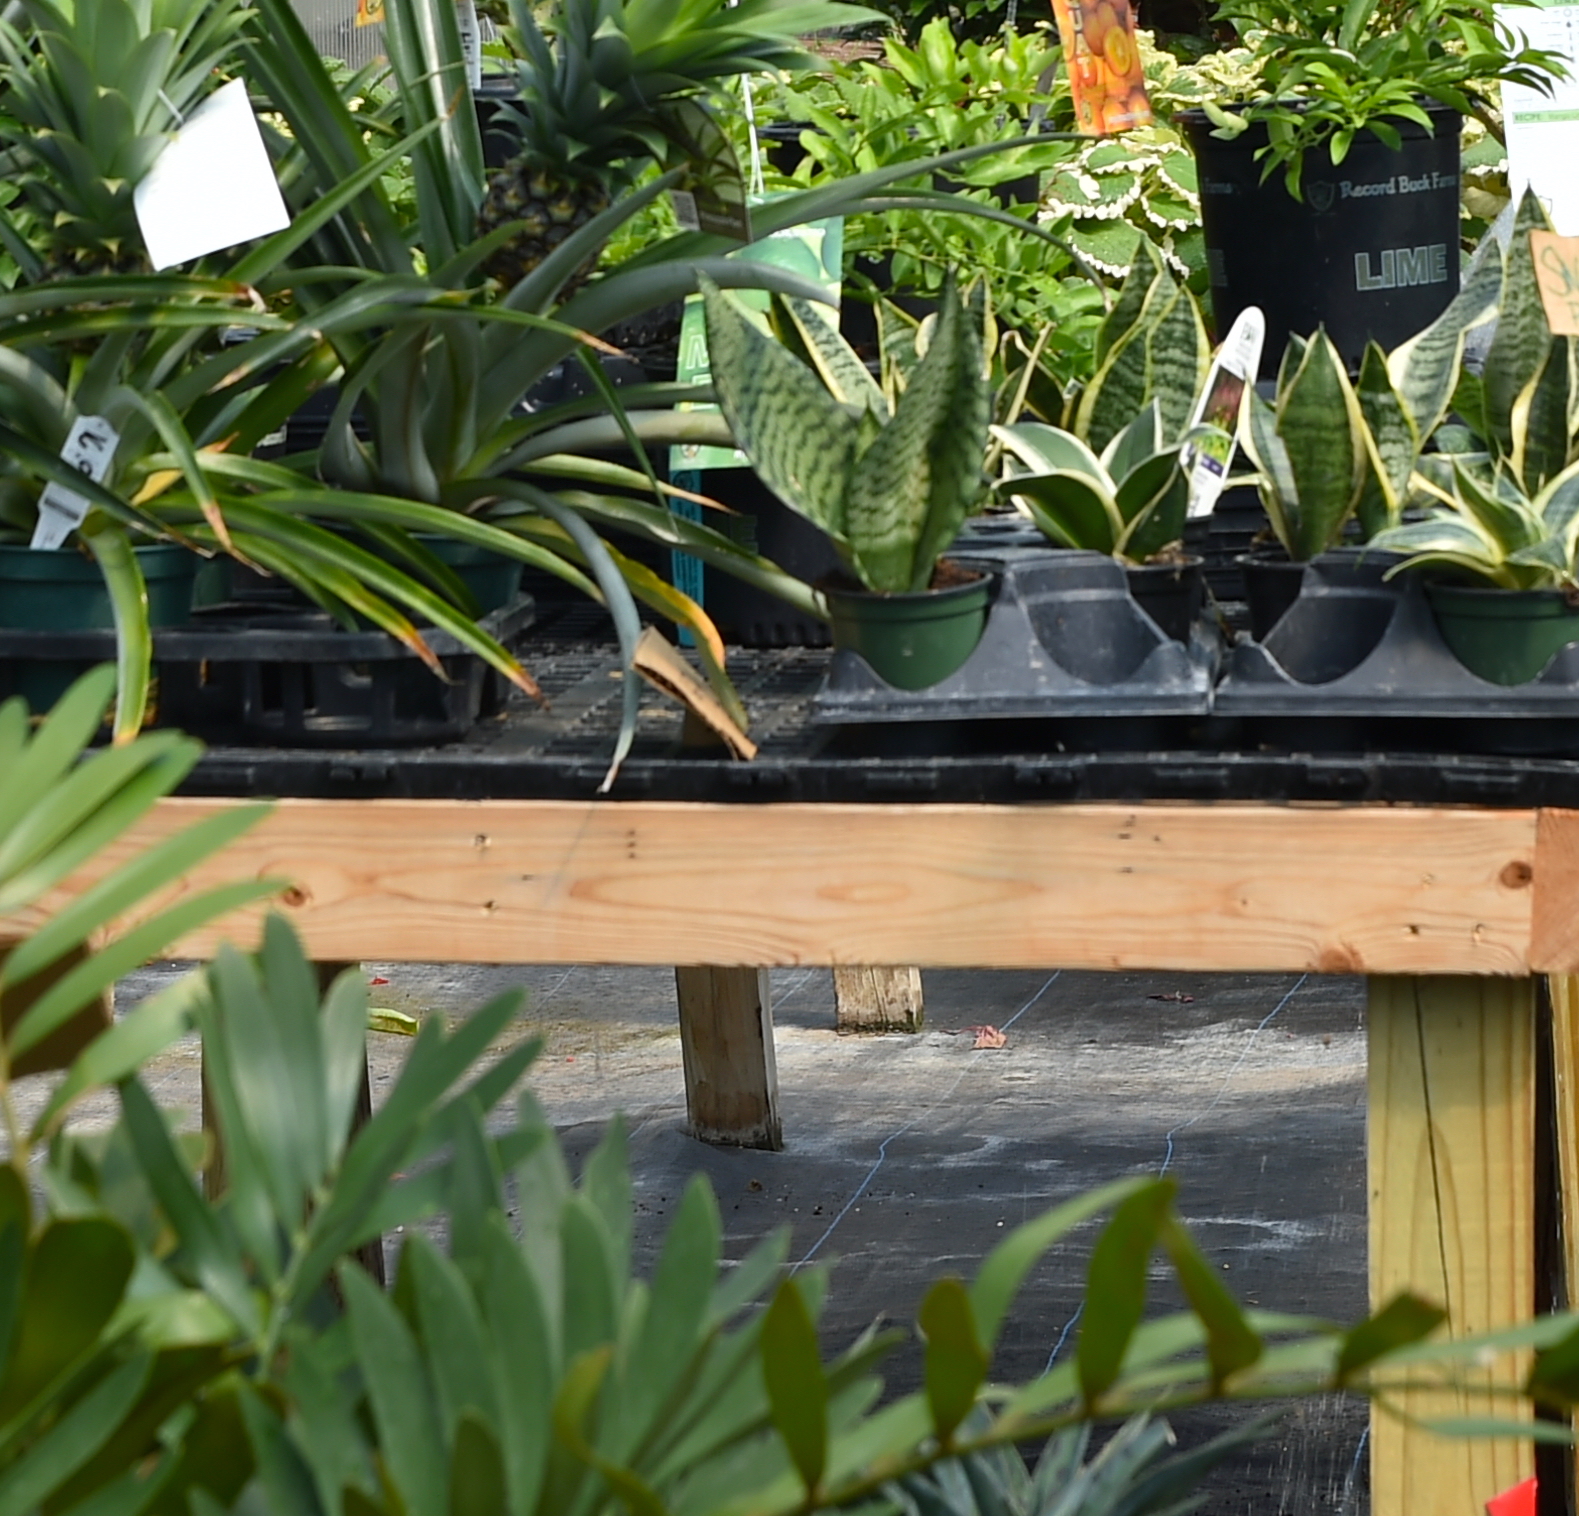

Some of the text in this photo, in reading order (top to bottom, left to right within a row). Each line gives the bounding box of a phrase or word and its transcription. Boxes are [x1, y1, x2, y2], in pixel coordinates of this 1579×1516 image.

[1339, 176, 1396, 199] Record
[1397, 173, 1431, 194] Buck
[1354, 243, 1448, 291] LIME
